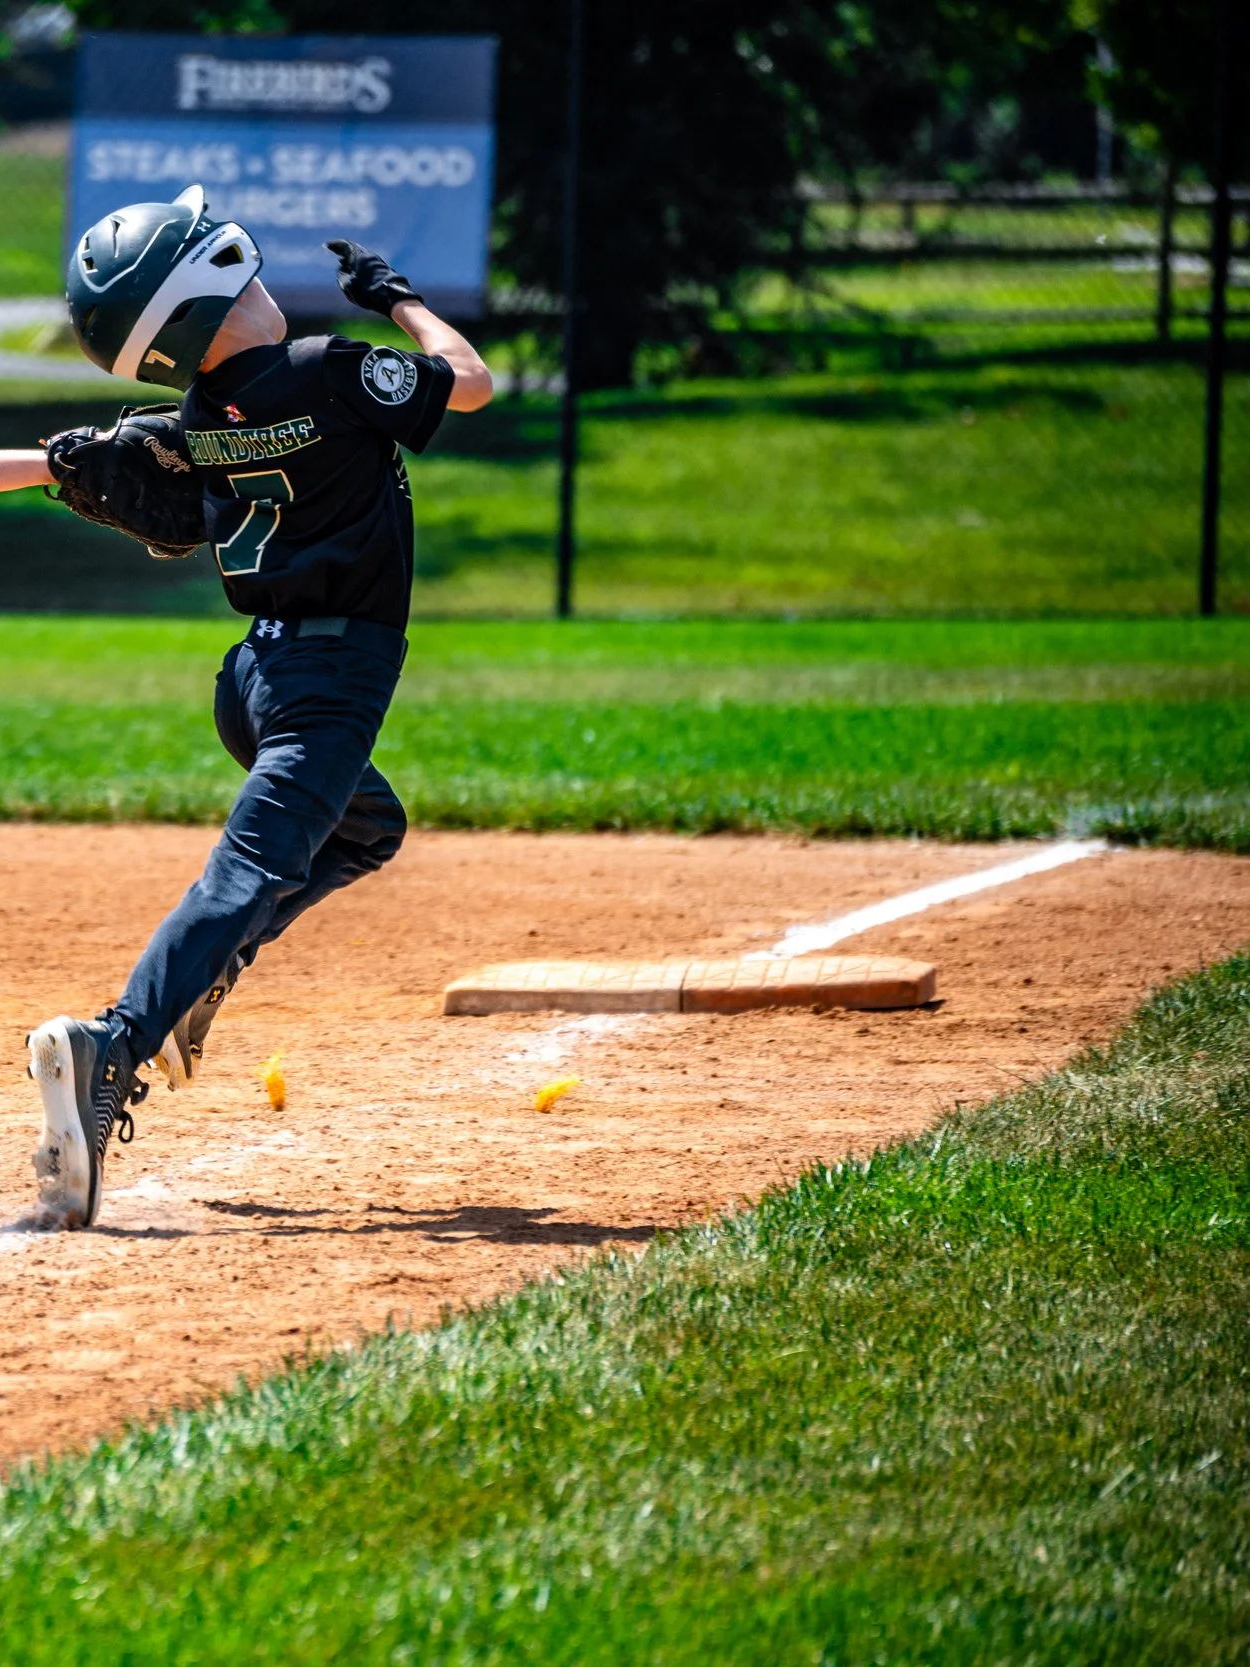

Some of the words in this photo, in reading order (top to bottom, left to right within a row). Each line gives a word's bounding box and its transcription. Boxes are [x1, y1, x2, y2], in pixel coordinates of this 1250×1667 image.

[88, 141, 241, 183] STEAKS
[271, 145, 476, 187] SEAFOOD
[205, 186, 378, 229] URGERS
[144, 349, 176, 369] 7
[143, 436, 191, 473] Rawlings
[185, 415, 322, 465] ROUNDTREE
[215, 469, 295, 577] 7
